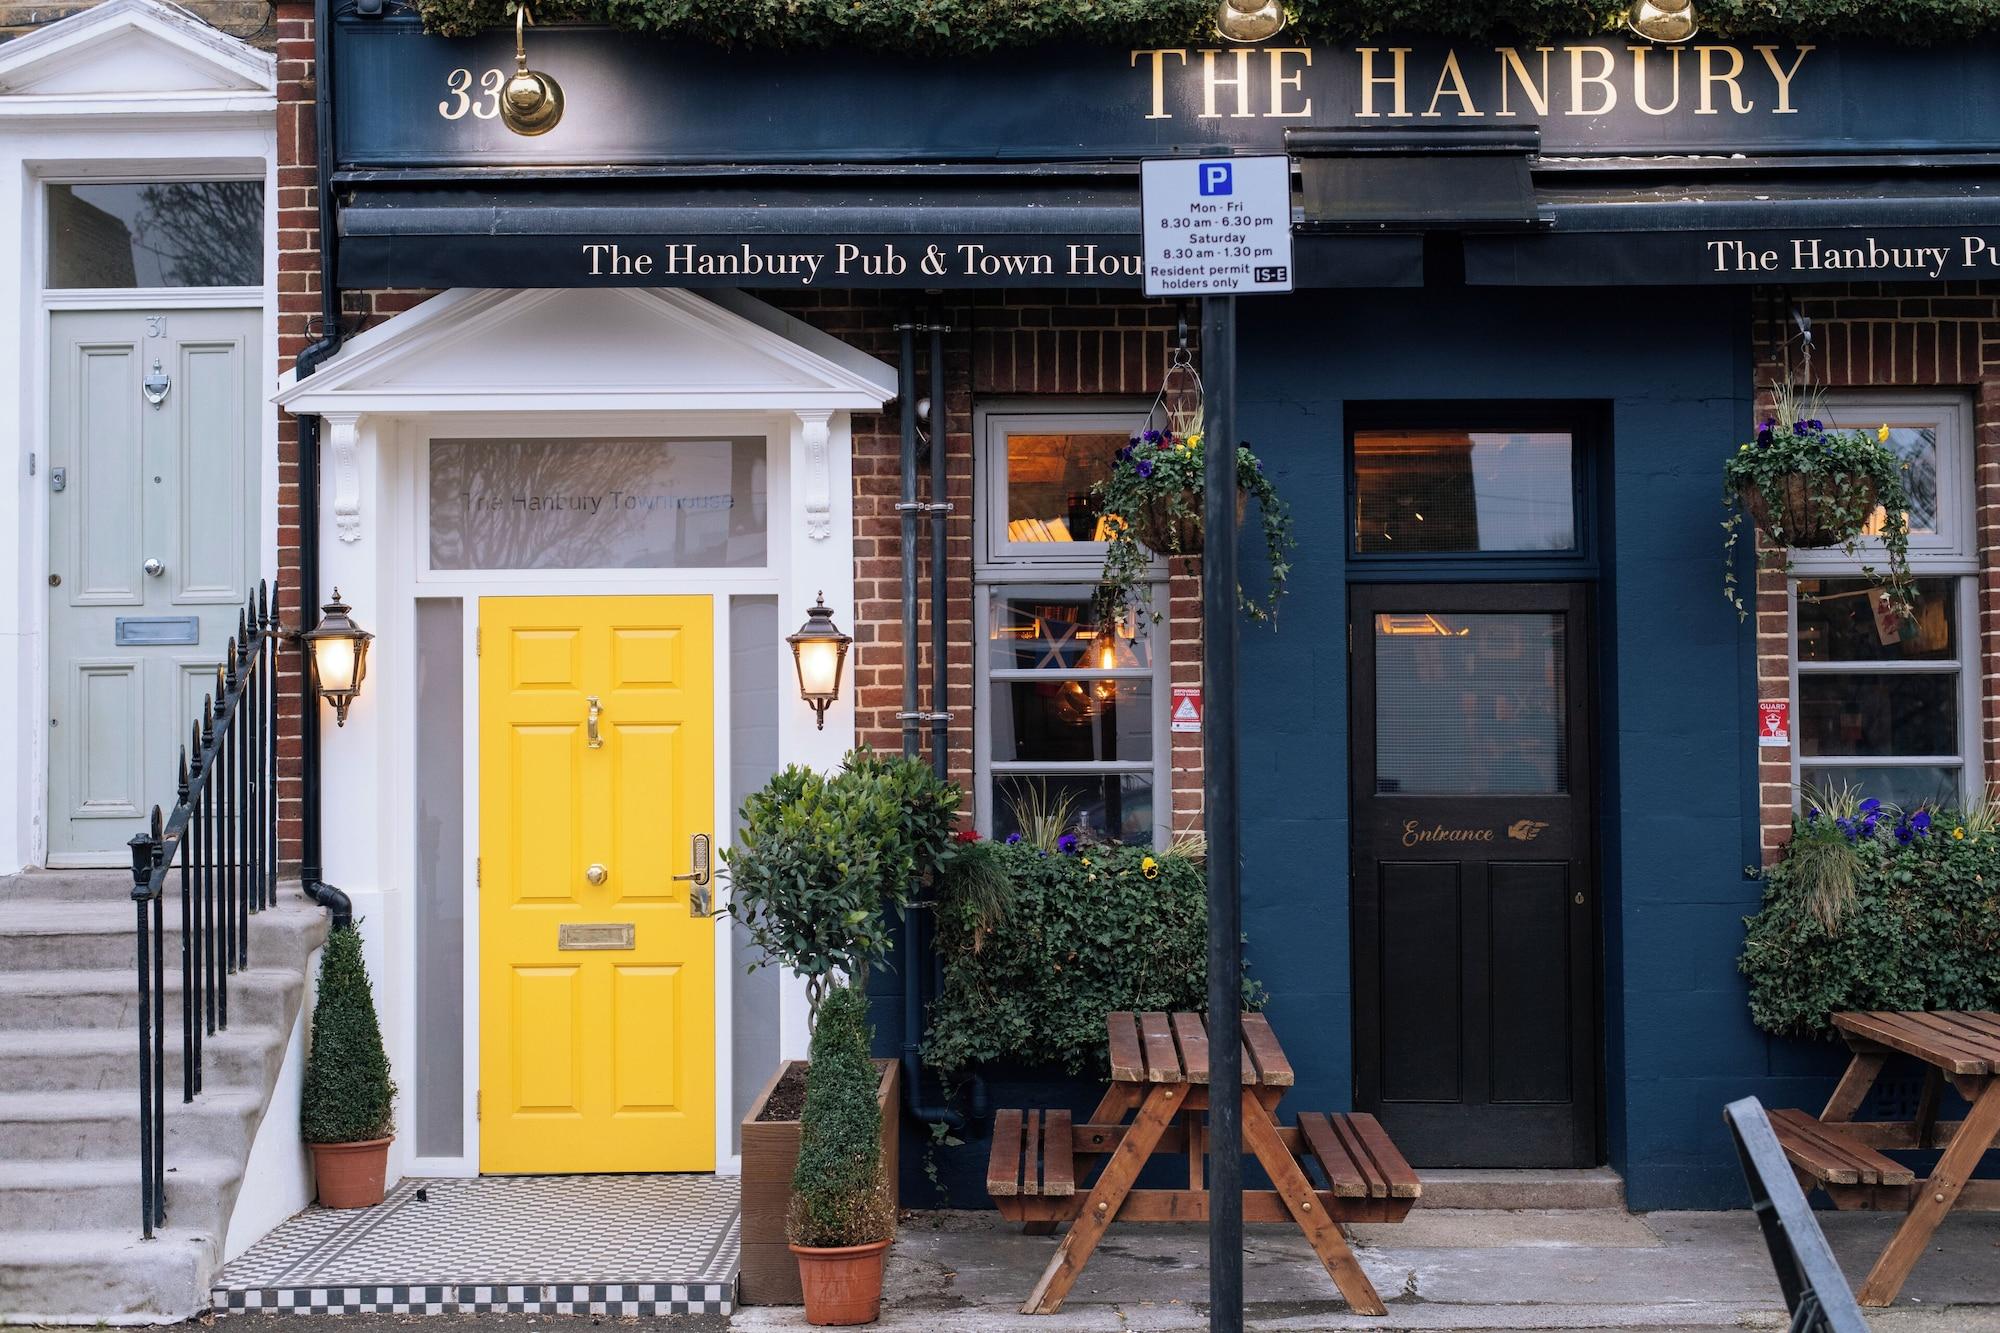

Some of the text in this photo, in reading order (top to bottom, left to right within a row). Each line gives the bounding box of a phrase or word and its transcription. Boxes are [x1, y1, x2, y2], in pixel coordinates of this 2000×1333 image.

[1131, 44, 1817, 120] THE HANBURY
[438, 68, 505, 120] 33
[1207, 166, 1228, 193] P
[1190, 203, 1217, 213] Mon
[1227, 201, 1243, 212] Fri
[1160, 217, 1191, 229] 8.30
[1194, 218, 1212, 228] am
[1222, 216, 1251, 227] 6.30
[1255, 216, 1273, 227] pm
[1189, 233, 1246, 245] Saturday
[582, 244, 653, 276] The
[664, 244, 824, 285] Hanbury
[835, 243, 907, 276] Pub
[920, 244, 948, 276] &
[957, 244, 1055, 276] Town
[1163, 248, 1193, 259] 8.30
[1196, 249, 1214, 259] am
[1224, 247, 1251, 257] 1.30
[1254, 247, 1273, 258] pm
[1707, 240, 1778, 272] The
[1790, 237, 1950, 278] Hanbury
[1151, 264, 1250, 276] Resident permit
[1256, 268, 1287, 282] IS-E
[1162, 277, 1239, 289] holders only
[145, 315, 168, 338] 31
[512, 491, 602, 515] Hanbury
[1401, 819, 1495, 847] Entrance
